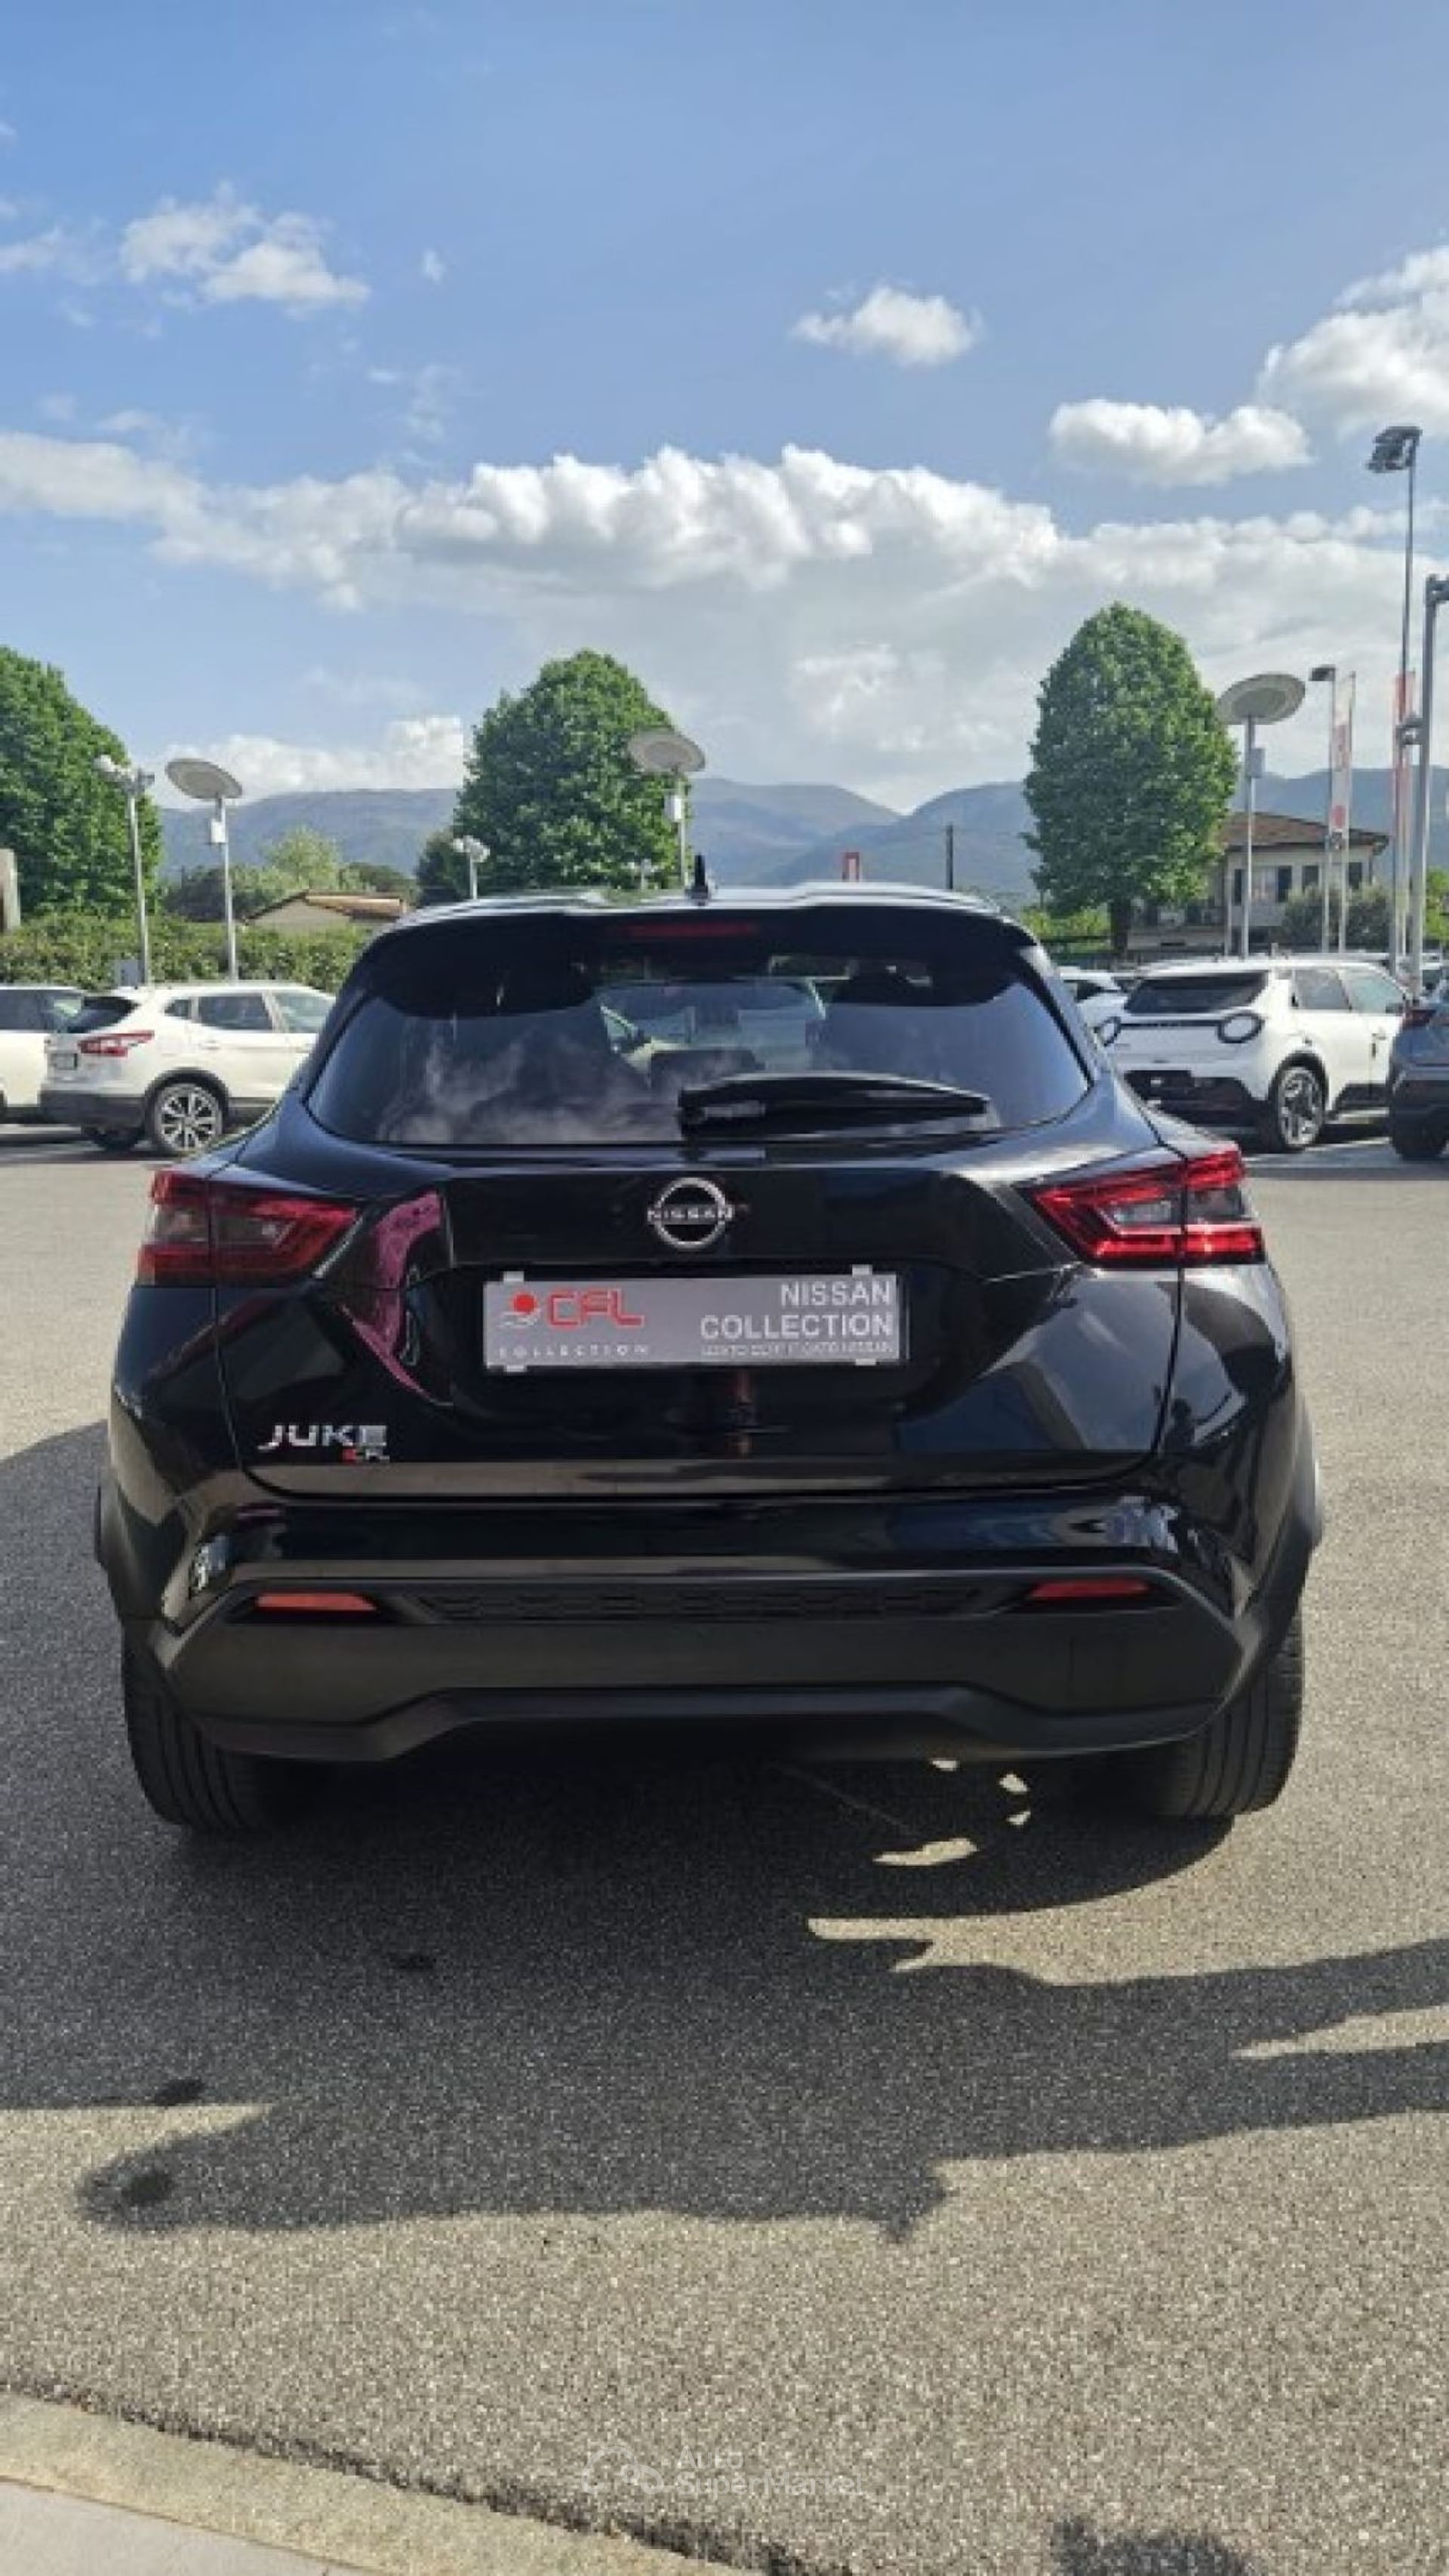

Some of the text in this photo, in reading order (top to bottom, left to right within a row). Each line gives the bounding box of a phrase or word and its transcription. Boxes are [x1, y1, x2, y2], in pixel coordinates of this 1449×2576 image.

[648, 1207, 734, 1220] NISSAN
[780, 1281, 891, 1306] NISSAN
[700, 1314, 894, 1339] COLLECTION
[257, 1424, 387, 1451] JUKE
